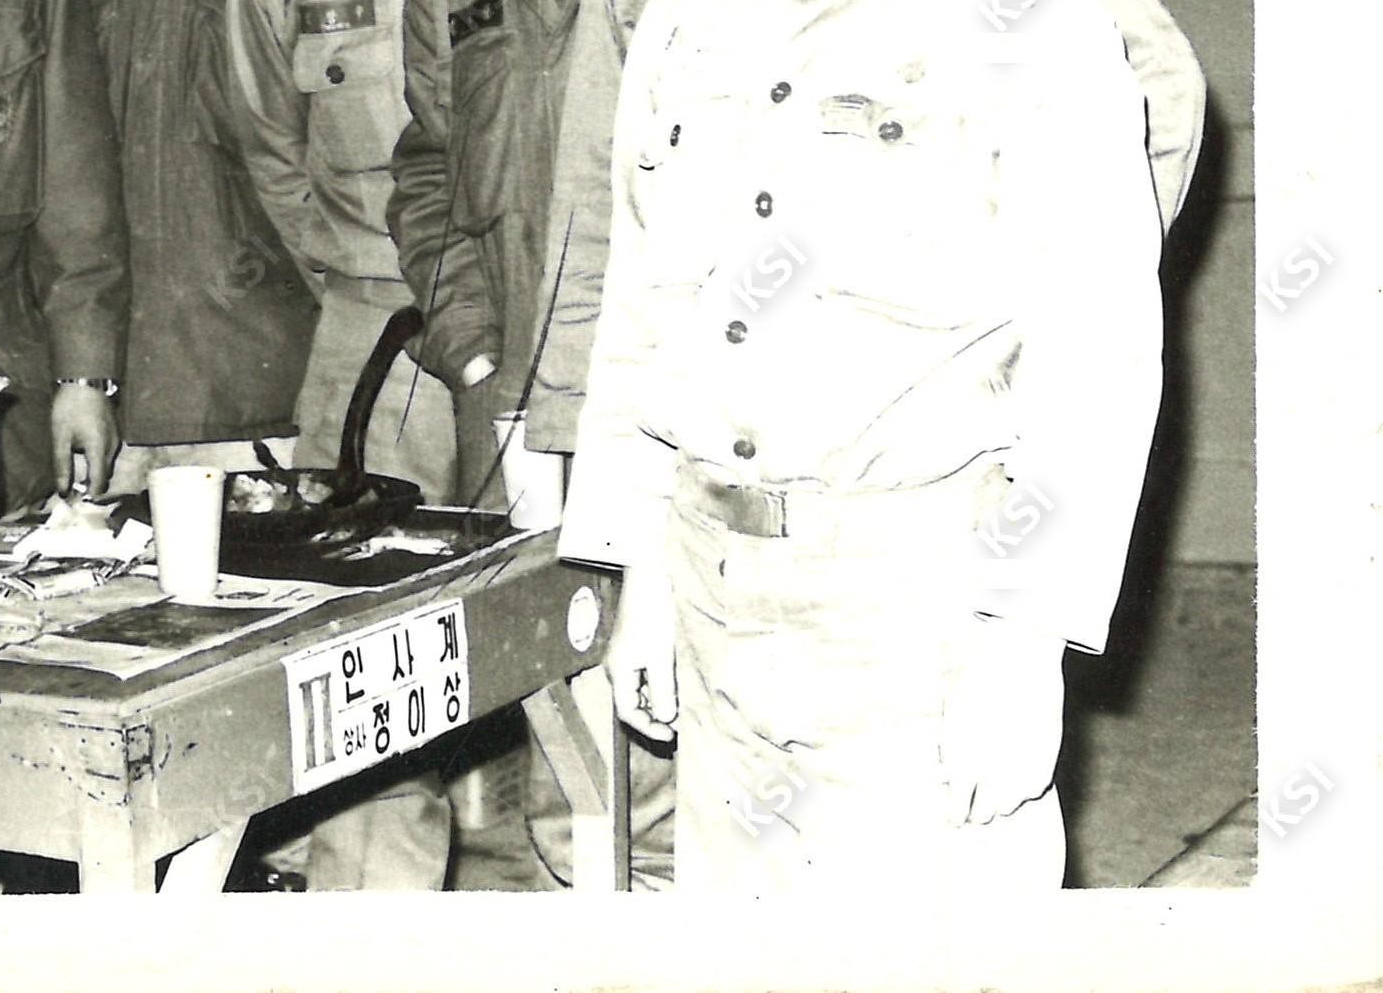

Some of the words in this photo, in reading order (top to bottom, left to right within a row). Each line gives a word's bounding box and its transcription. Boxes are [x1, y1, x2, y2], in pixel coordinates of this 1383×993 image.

[341, 612, 459, 704] 인사계
[343, 722, 367, 756] 상사
[373, 672, 461, 754] 정이상
